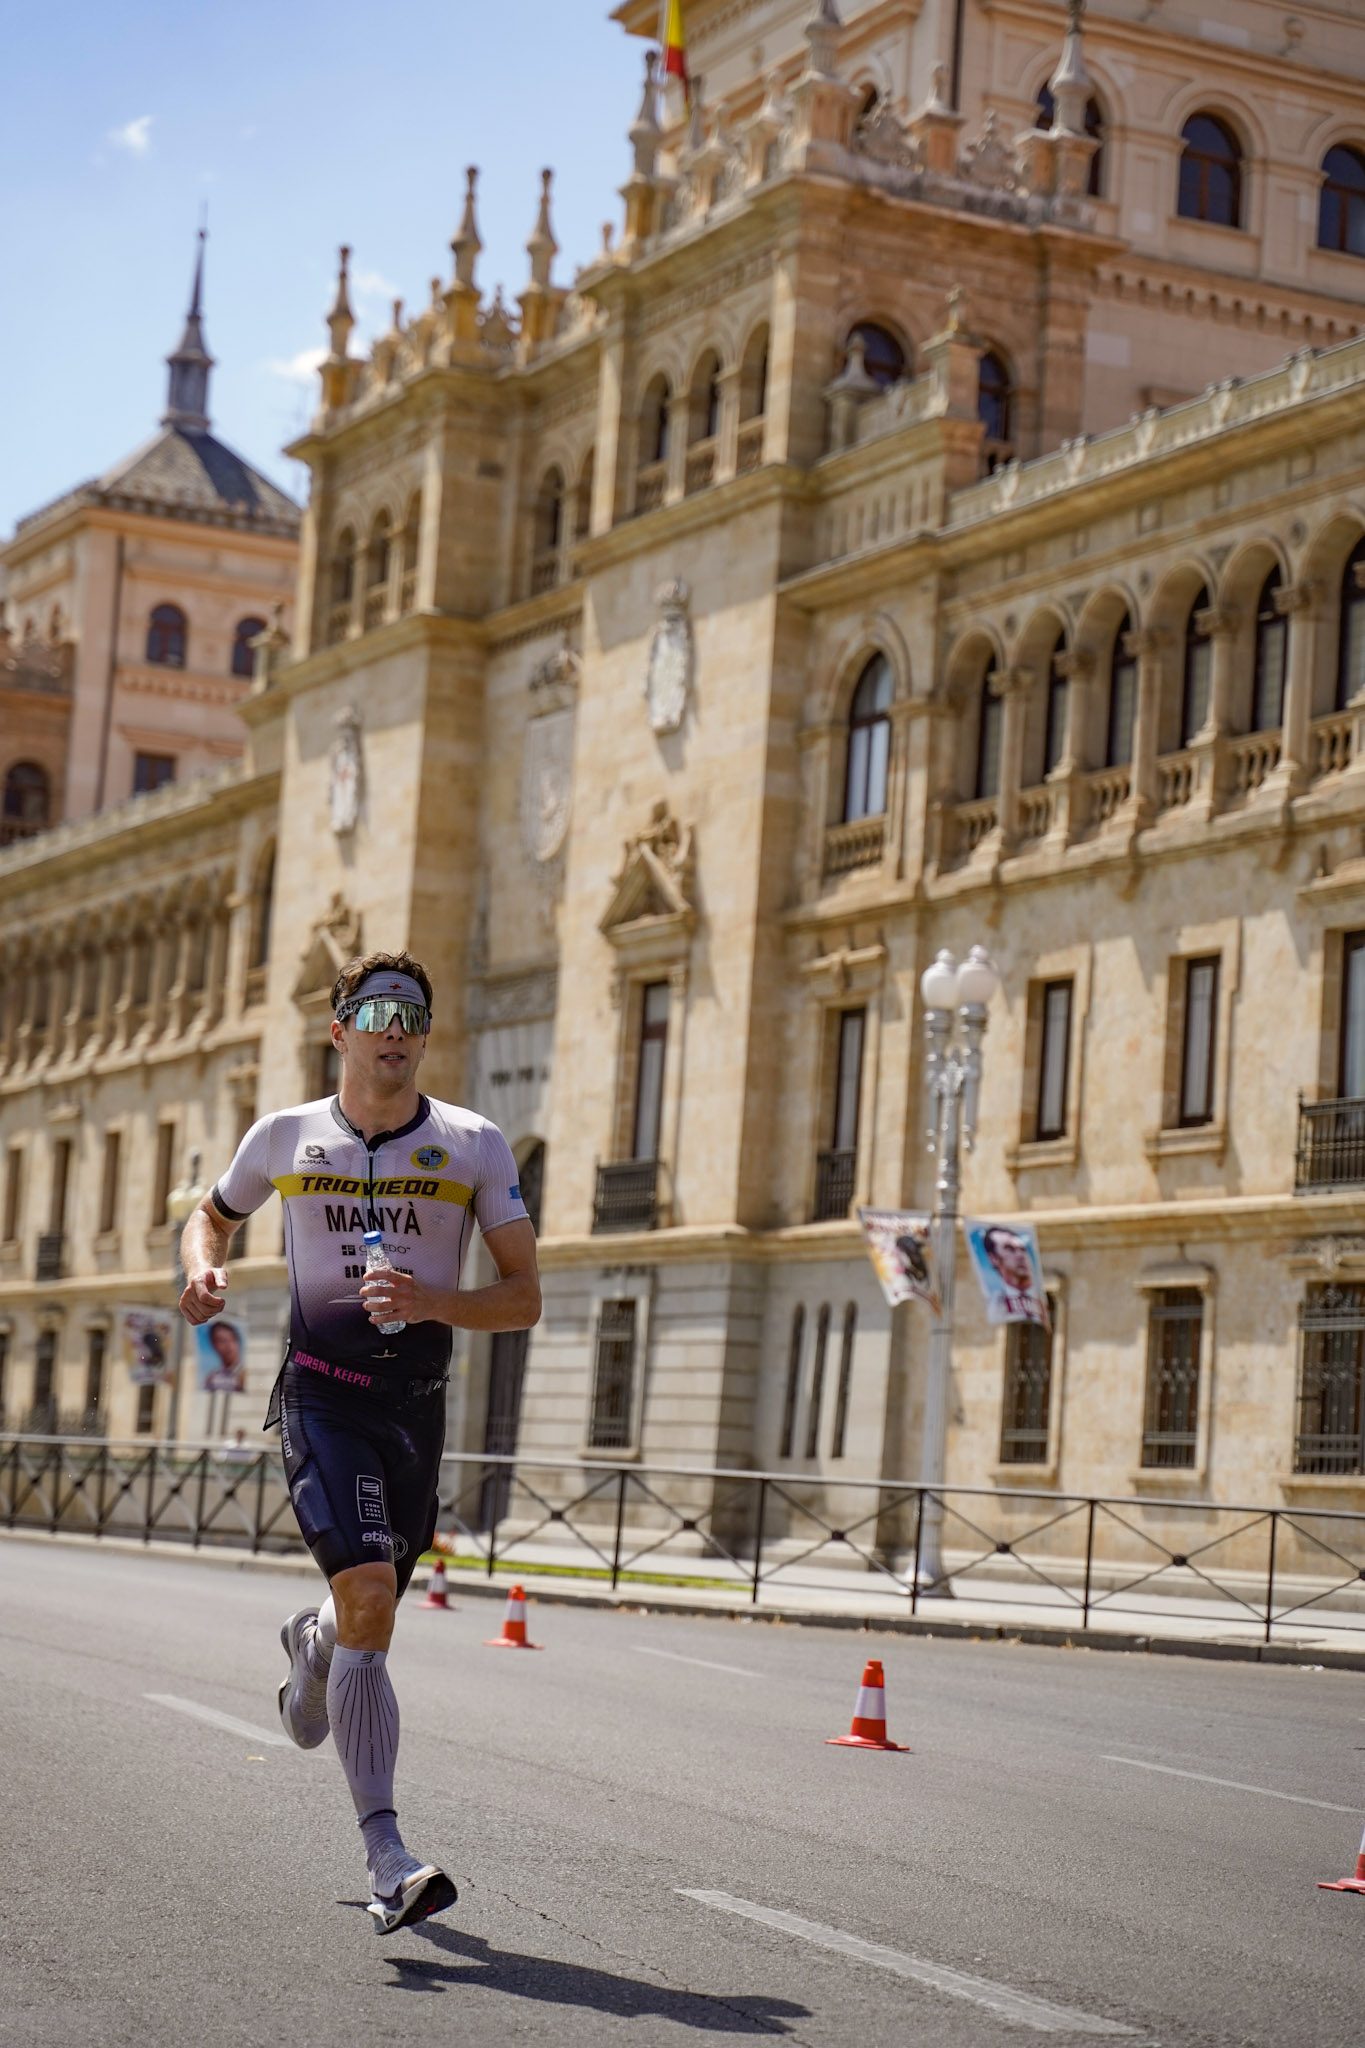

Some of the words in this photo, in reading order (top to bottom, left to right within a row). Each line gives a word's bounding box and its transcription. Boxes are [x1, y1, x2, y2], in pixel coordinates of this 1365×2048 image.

[301, 1176, 439, 1196] TRIOVIEDO
[325, 1201, 421, 1235] MANYÀ
[294, 1351, 330, 1376] DORSAL
[281, 1392, 293, 1458] TRIOVIEDO
